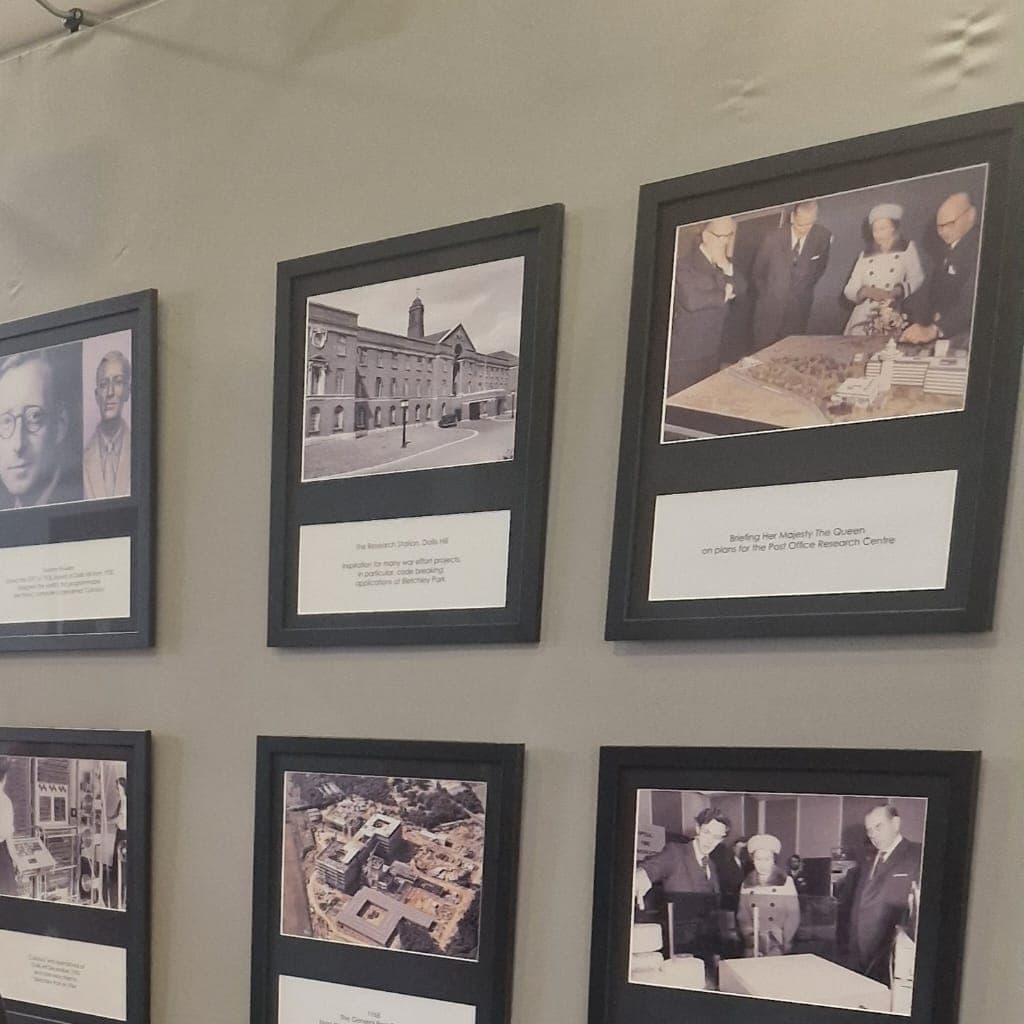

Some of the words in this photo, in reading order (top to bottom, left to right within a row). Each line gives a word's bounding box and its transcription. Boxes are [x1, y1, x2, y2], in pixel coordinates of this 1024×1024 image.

[729, 533, 760, 543] Briefing
[762, 532, 776, 540] Her
[779, 530, 814, 540] Majesty
[816, 528, 831, 537] The
[833, 526, 866, 536] Queen
[701, 547, 713, 555] on
[714, 545, 737, 555] plans
[739, 544, 750, 553] for
[752, 543, 767, 552] the
[768, 542, 787, 551] Post
[788, 540, 816, 550] Office
[818, 538, 860, 549] Research
[862, 536, 896, 546] Centre
[397, 568, 414, 576] code
[415, 567, 444, 576] breaking
